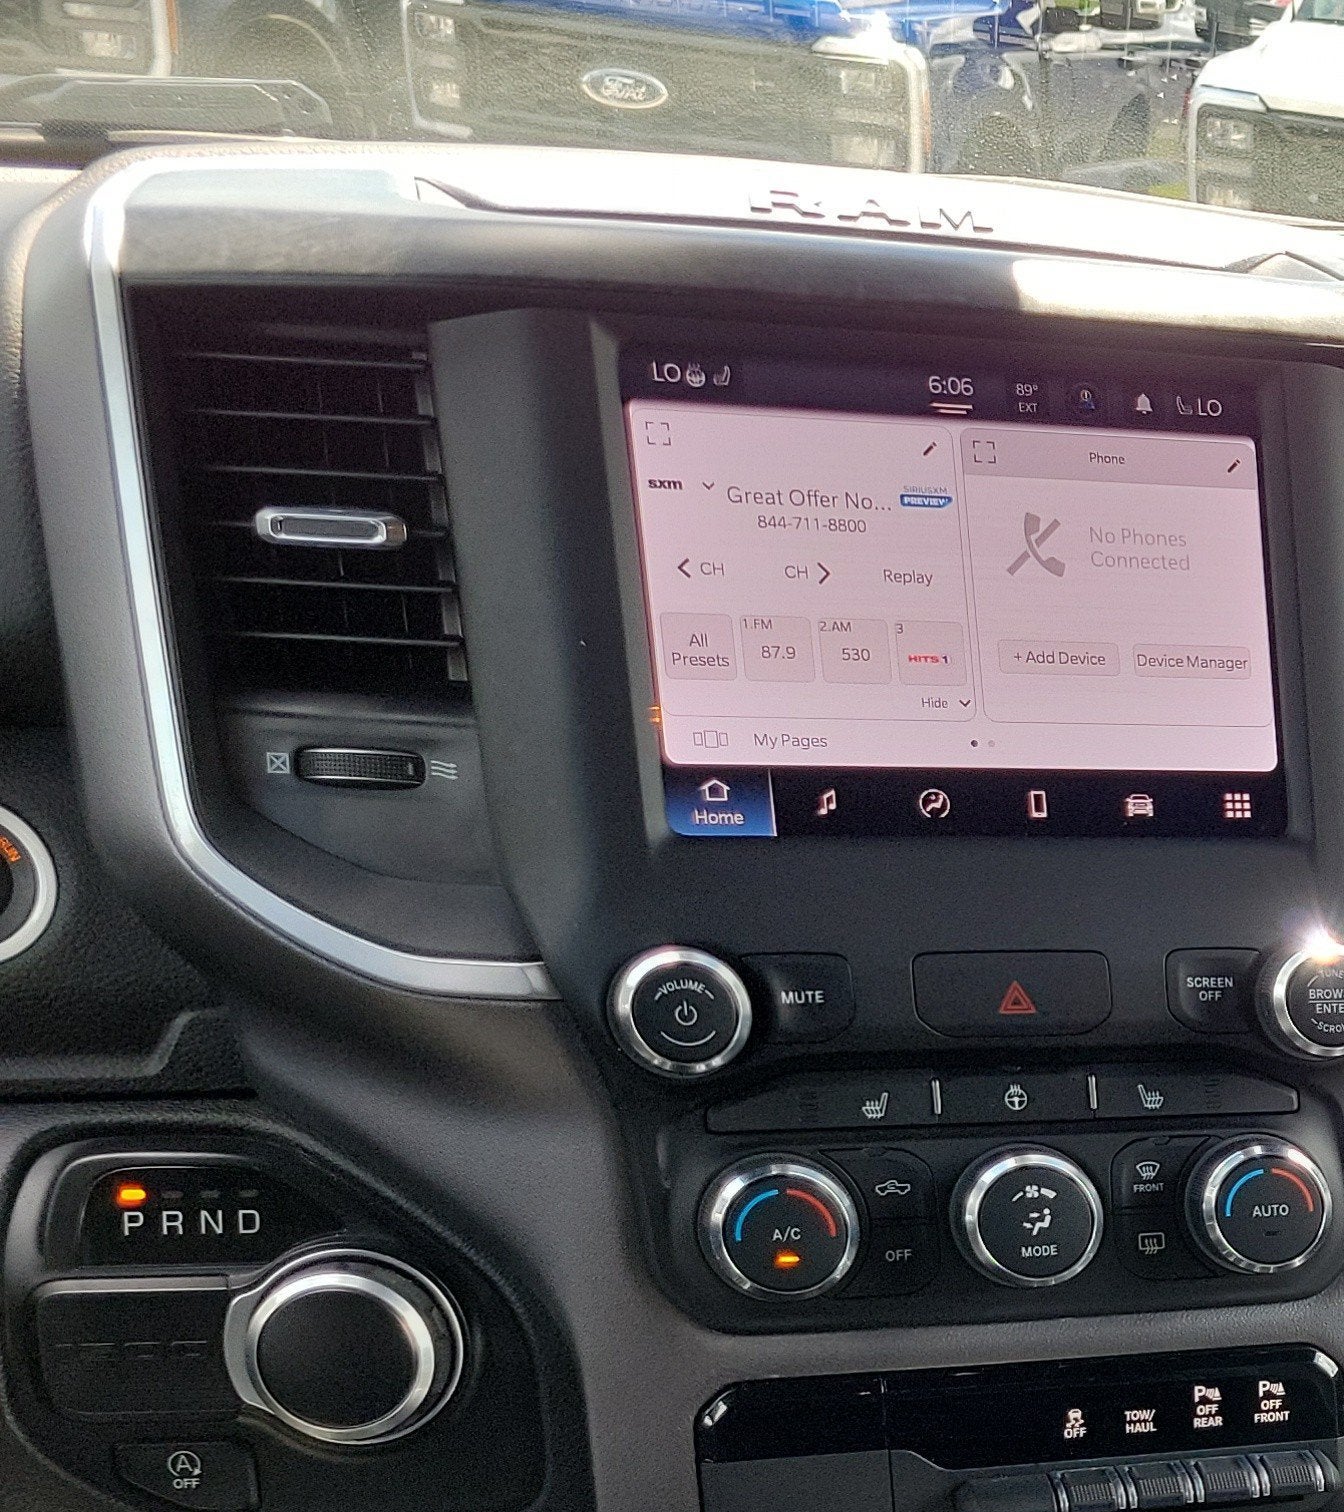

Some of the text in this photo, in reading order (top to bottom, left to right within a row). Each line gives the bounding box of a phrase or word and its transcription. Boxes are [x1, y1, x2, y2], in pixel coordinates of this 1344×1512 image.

[749, 190, 994, 233] RAM
[652, 361, 682, 383] LO
[928, 375, 974, 396] 6:06
[1018, 402, 1038, 413] EXT
[1198, 398, 1222, 417] LO
[1089, 452, 1126, 465] Phone
[727, 486, 783, 507] Great
[789, 490, 839, 509] Offer
[904, 496, 949, 506] PREVIEW
[757, 514, 867, 533] 844-711-8800
[1089, 526, 1187, 547] No Phones
[1090, 551, 1190, 571] Connected
[700, 562, 725, 576] CH
[784, 565, 808, 580] CH
[883, 569, 933, 586] Replay
[689, 633, 708, 648] All
[761, 645, 796, 660] 87.9
[842, 648, 871, 662] 530
[908, 654, 949, 665] HITS 1
[1026, 650, 1055, 665] Add
[1059, 652, 1106, 666] Device
[672, 652, 730, 668] Presets
[1137, 653, 1248, 672] Device Manager
[921, 697, 948, 709] Hide
[754, 733, 828, 750] My Pages
[694, 808, 745, 826] Home
[1320, 969, 1344, 979] TUNE
[660, 978, 706, 994] VOLUME
[1186, 977, 1234, 988] SCREEN
[781, 990, 825, 1004] MUTE
[1199, 991, 1222, 1002] OFF
[1133, 1182, 1165, 1194] FRONT
[1252, 1204, 1290, 1218] AUTO
[123, 1209, 261, 1236] P R N D
[772, 1225, 801, 1241] A/C
[885, 1249, 913, 1262] OFF
[1021, 1244, 1059, 1258] MODE
[1196, 1404, 1219, 1416] OFF
[1261, 1399, 1283, 1411] OFF
[1124, 1409, 1156, 1422] TOW/
[1193, 1416, 1223, 1429] REAR
[1254, 1410, 1291, 1424] FRONT
[1064, 1427, 1087, 1440] OFF
[1125, 1422, 1157, 1434] HAUL
[173, 1478, 200, 1489] OFF
